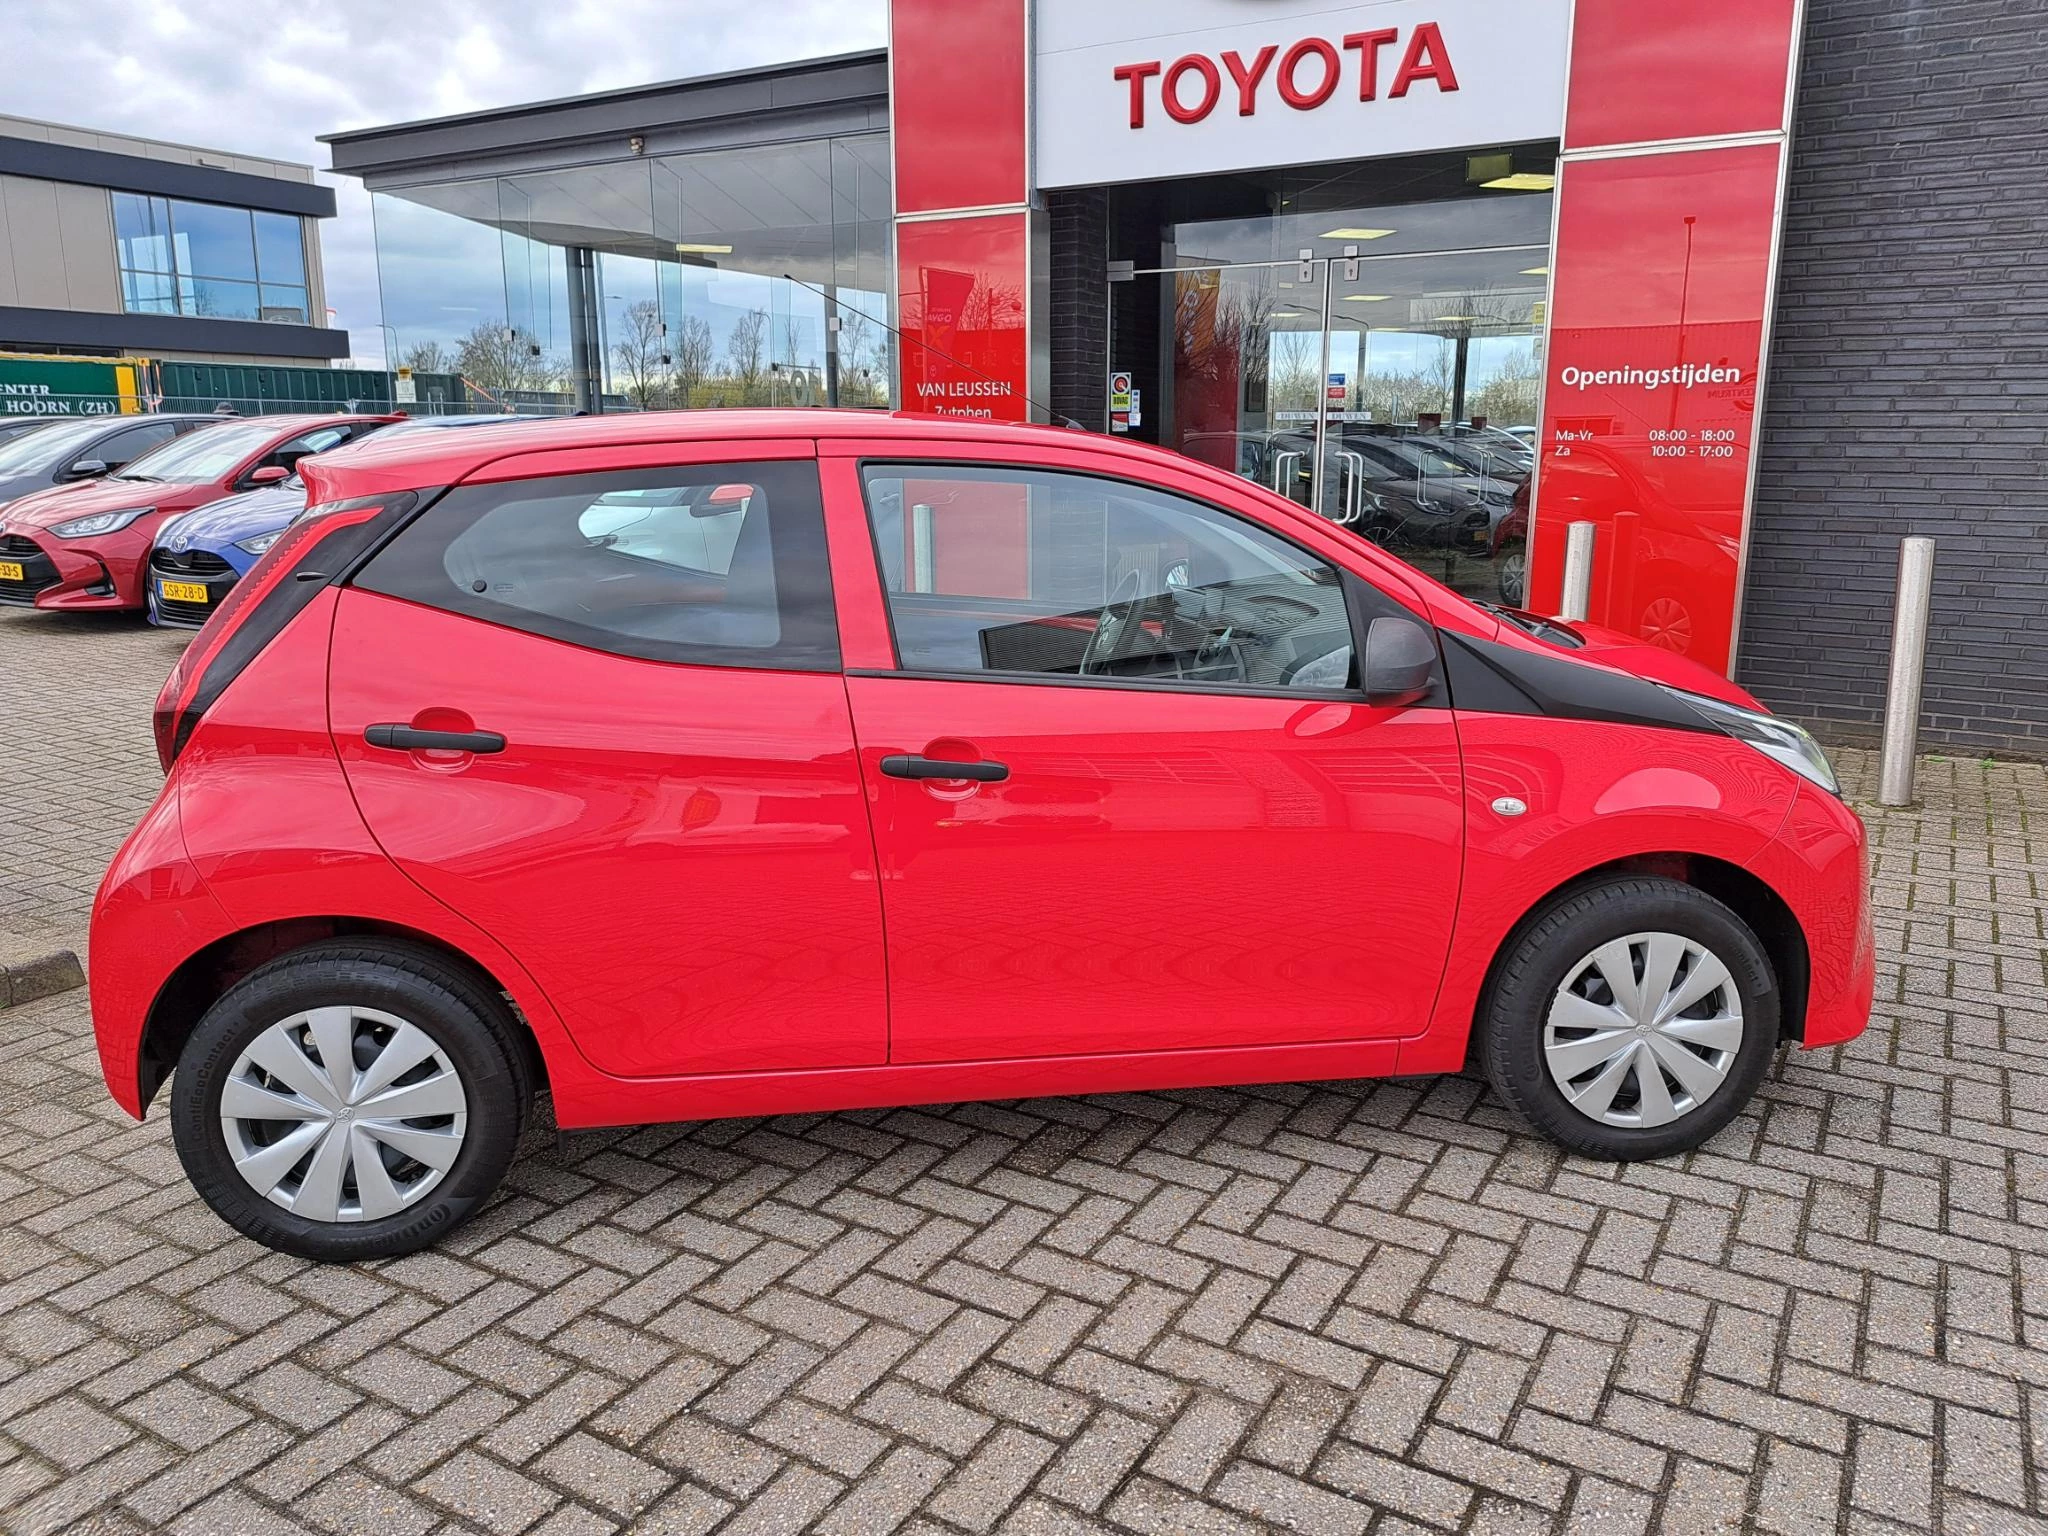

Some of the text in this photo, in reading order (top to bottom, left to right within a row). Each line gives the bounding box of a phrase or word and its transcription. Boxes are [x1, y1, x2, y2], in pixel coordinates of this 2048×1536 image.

[1114, 21, 1459, 129] TOYOTA
[1561, 363, 1741, 390] Openingstijden
[917, 381, 1011, 396] VAN LEUSSEN
[6, 400, 116, 415] HOORN (ZH)
[1555, 430, 1594, 441] Ma-Vr
[1649, 430, 1687, 441] 08:00
[1700, 429, 1735, 441] 18:00
[1555, 446, 1570, 456] Za
[1652, 446, 1686, 457] 10:00
[1699, 446, 1733, 457] 17:00
[163, 582, 205, 600] GSR-28-D
